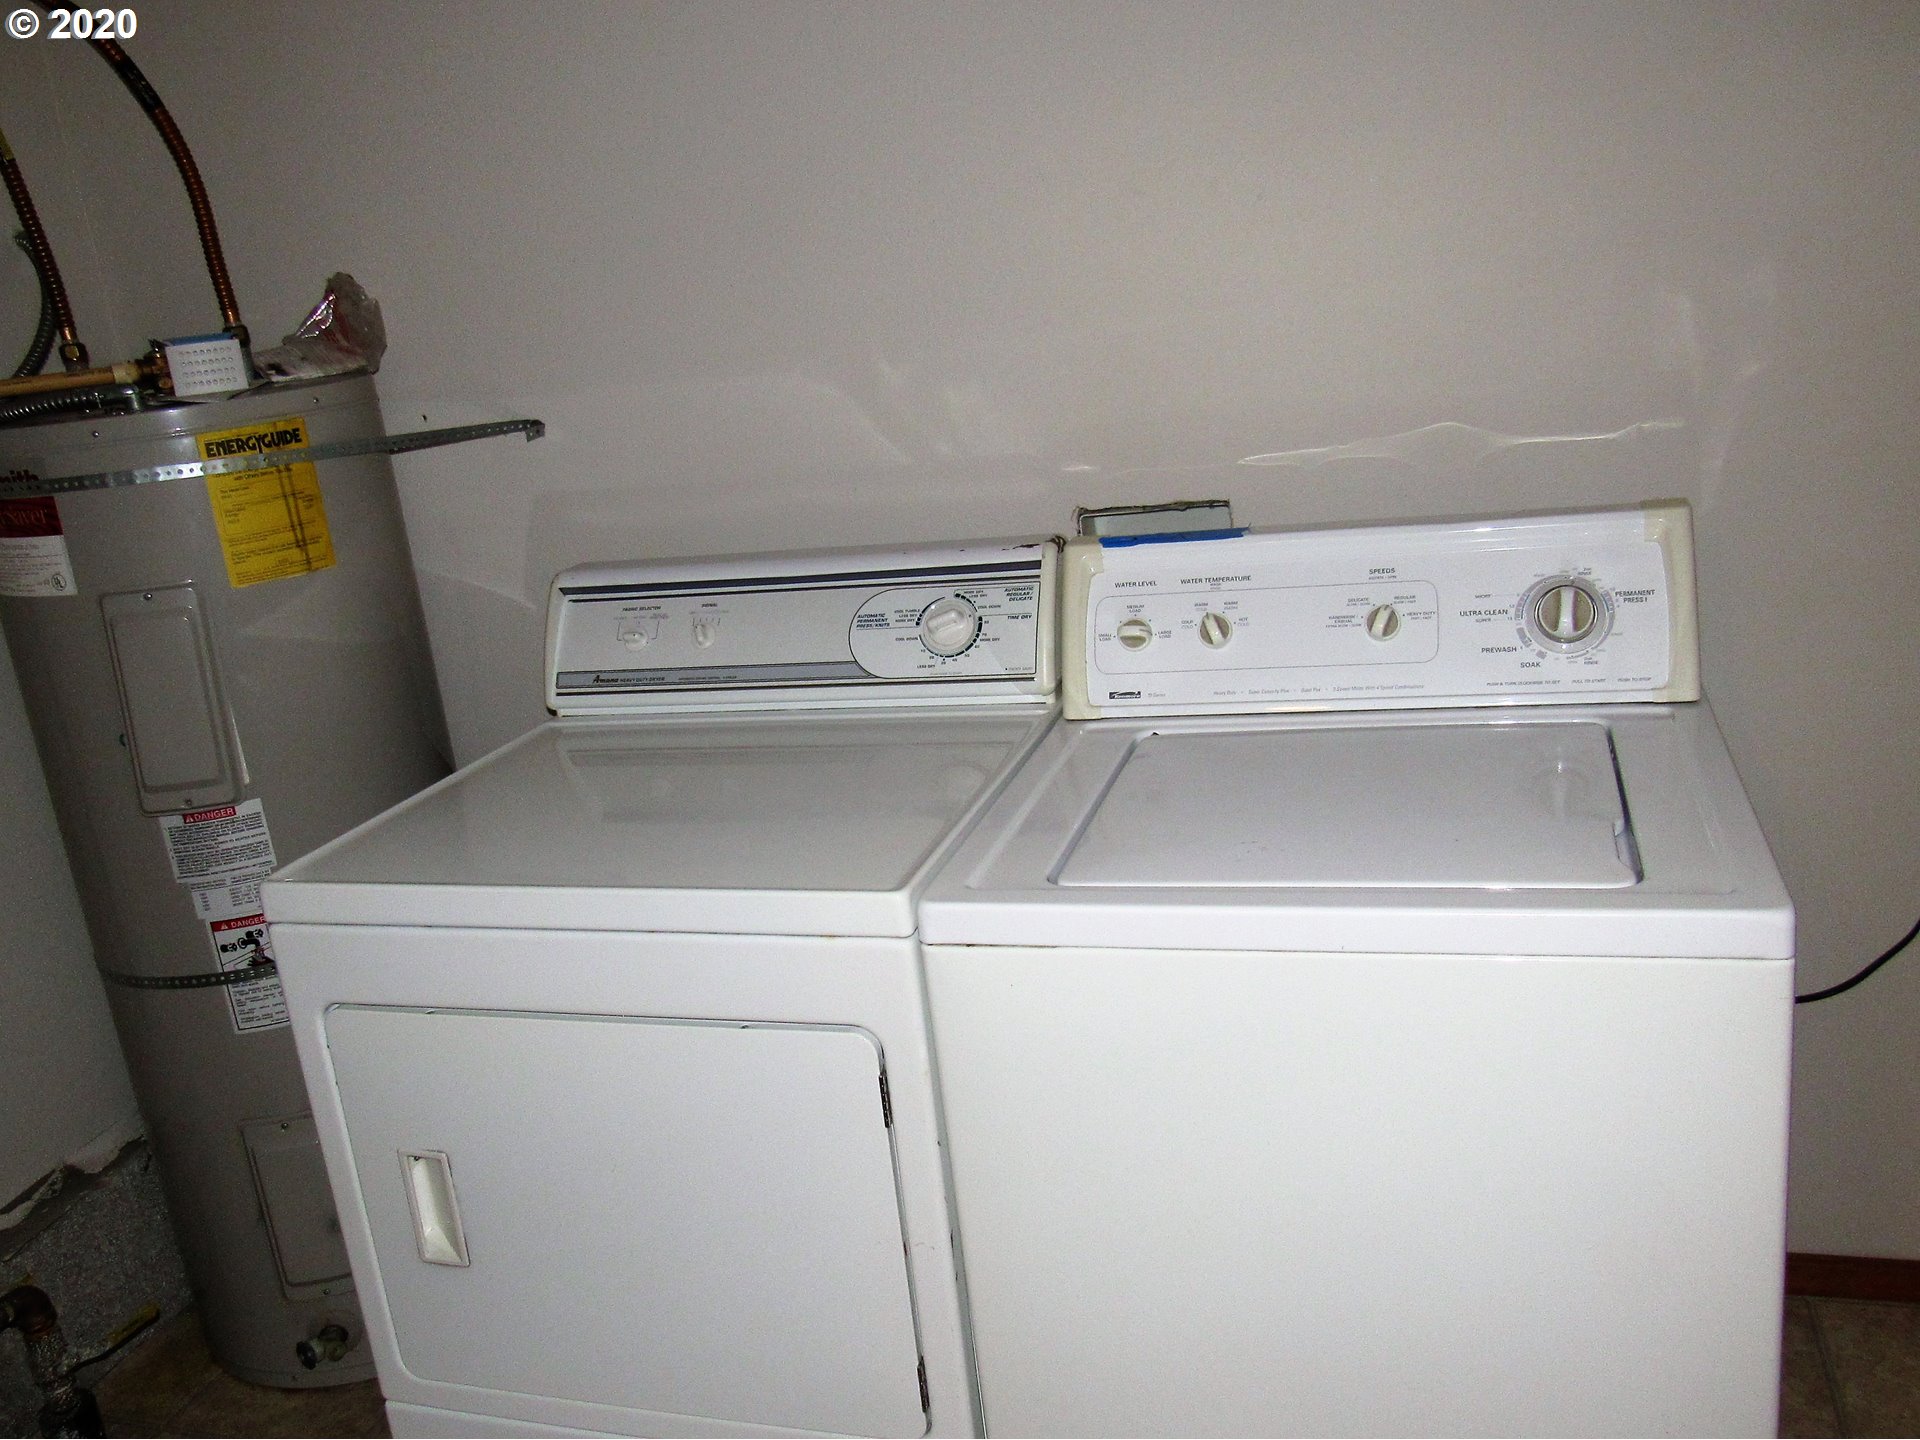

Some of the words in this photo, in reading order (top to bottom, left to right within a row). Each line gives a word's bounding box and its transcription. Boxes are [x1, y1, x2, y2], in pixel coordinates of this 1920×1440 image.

[204, 428, 303, 458] ENERGYGUIDE
[1369, 567, 1396, 575] SPEEDS
[1204, 575, 1251, 583] TEMPERATURE
[1615, 589, 1655, 597] PERMANENT
[1481, 646, 1517, 654] PREWASH
[195, 807, 235, 820] DANGER
